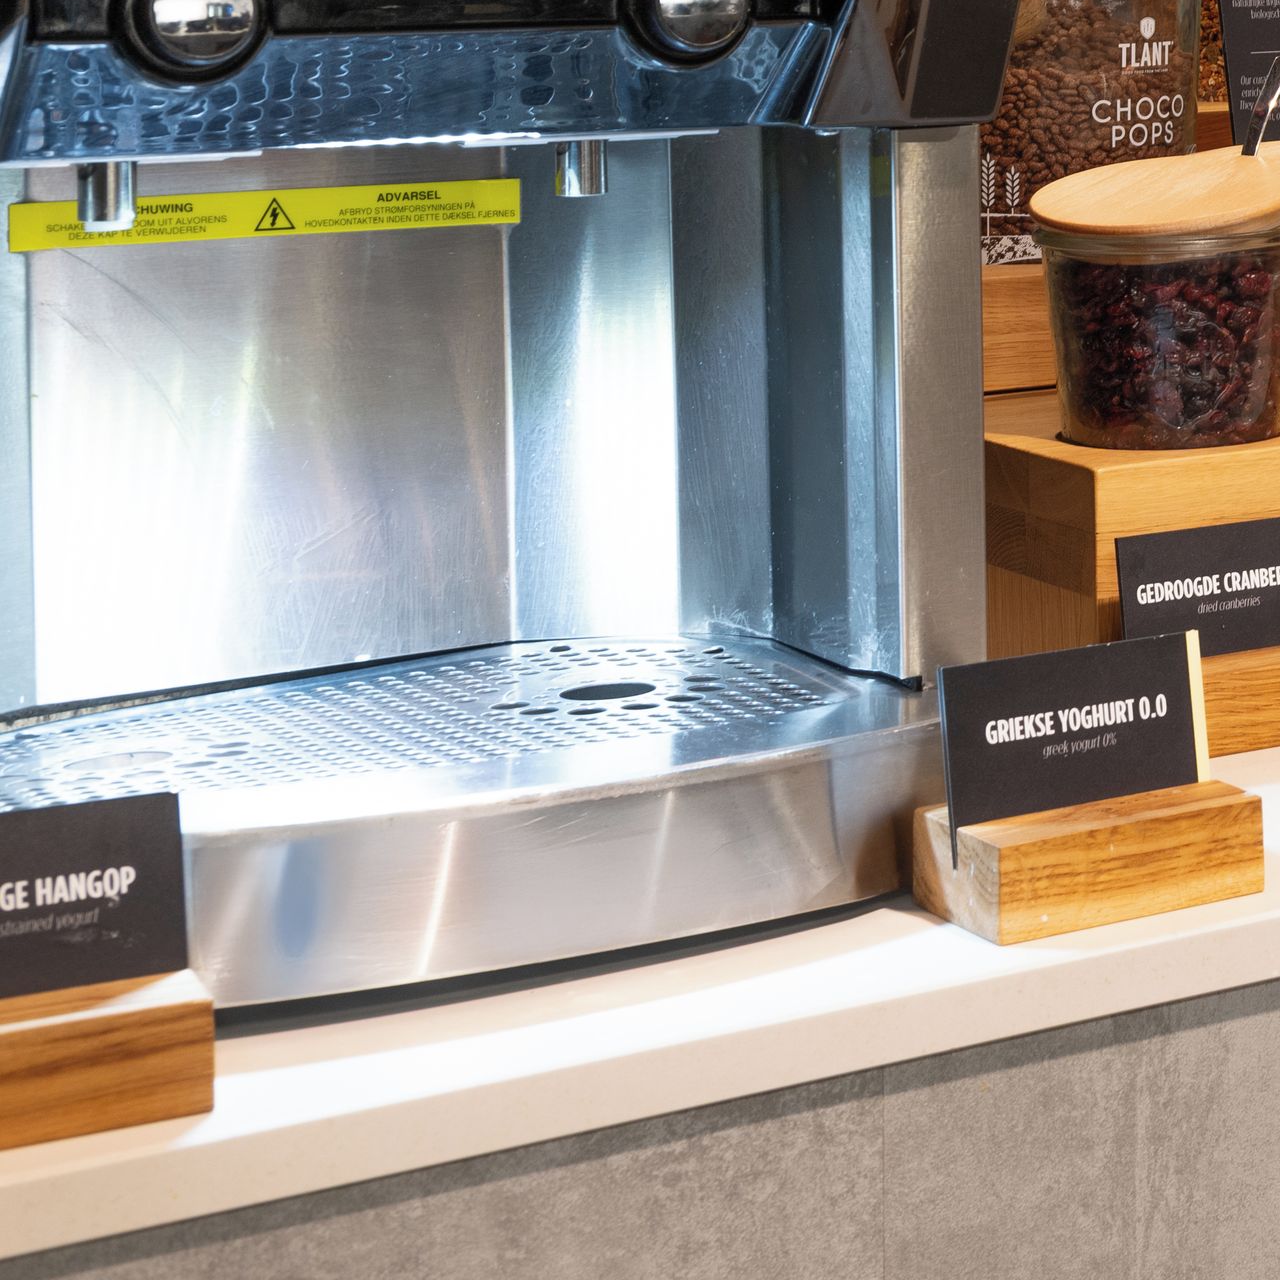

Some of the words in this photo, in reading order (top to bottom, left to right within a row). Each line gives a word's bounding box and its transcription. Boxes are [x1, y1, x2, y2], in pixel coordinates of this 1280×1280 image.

[1118, 40, 1172, 68] TLANT
[1240, 75, 1251, 85] Our
[1092, 94, 1184, 123] CHOCO
[1112, 121, 1173, 148] POPS
[377, 191, 441, 202] ADVARSEL
[305, 216, 384, 228] HOVEDKONTAKTEN
[386, 215, 412, 224] INDEN
[414, 213, 441, 222] DETTE
[442, 211, 476, 221] DÆKSEL
[478, 210, 516, 219] FJERNES
[339, 208, 372, 217] AFBRYD
[374, 204, 462, 215] STRØMFORSYNINGEN
[465, 201, 476, 210] PÅ
[159, 218, 173, 227] UIT
[175, 215, 227, 226] ALVORENS
[68, 232, 95, 241] DEZE
[121, 229, 133, 237] TE
[136, 225, 206, 236] VERWIJDEREN
[1137, 574, 1221, 605] GEDROOGDE
[1198, 600, 1218, 614] dried
[1219, 595, 1261, 611] cranberries
[985, 712, 1055, 745] GRIEKSE
[1057, 699, 1135, 733] YOGHURT
[1138, 693, 1167, 720] 0.0
[1043, 738, 1068, 759] greek
[1071, 734, 1100, 755] yogurt
[1103, 732, 1117, 746] 0%
[0, 880, 30, 911] GE
[35, 866, 136, 906] HANGOP
[56, 907, 99, 930] yogurt
